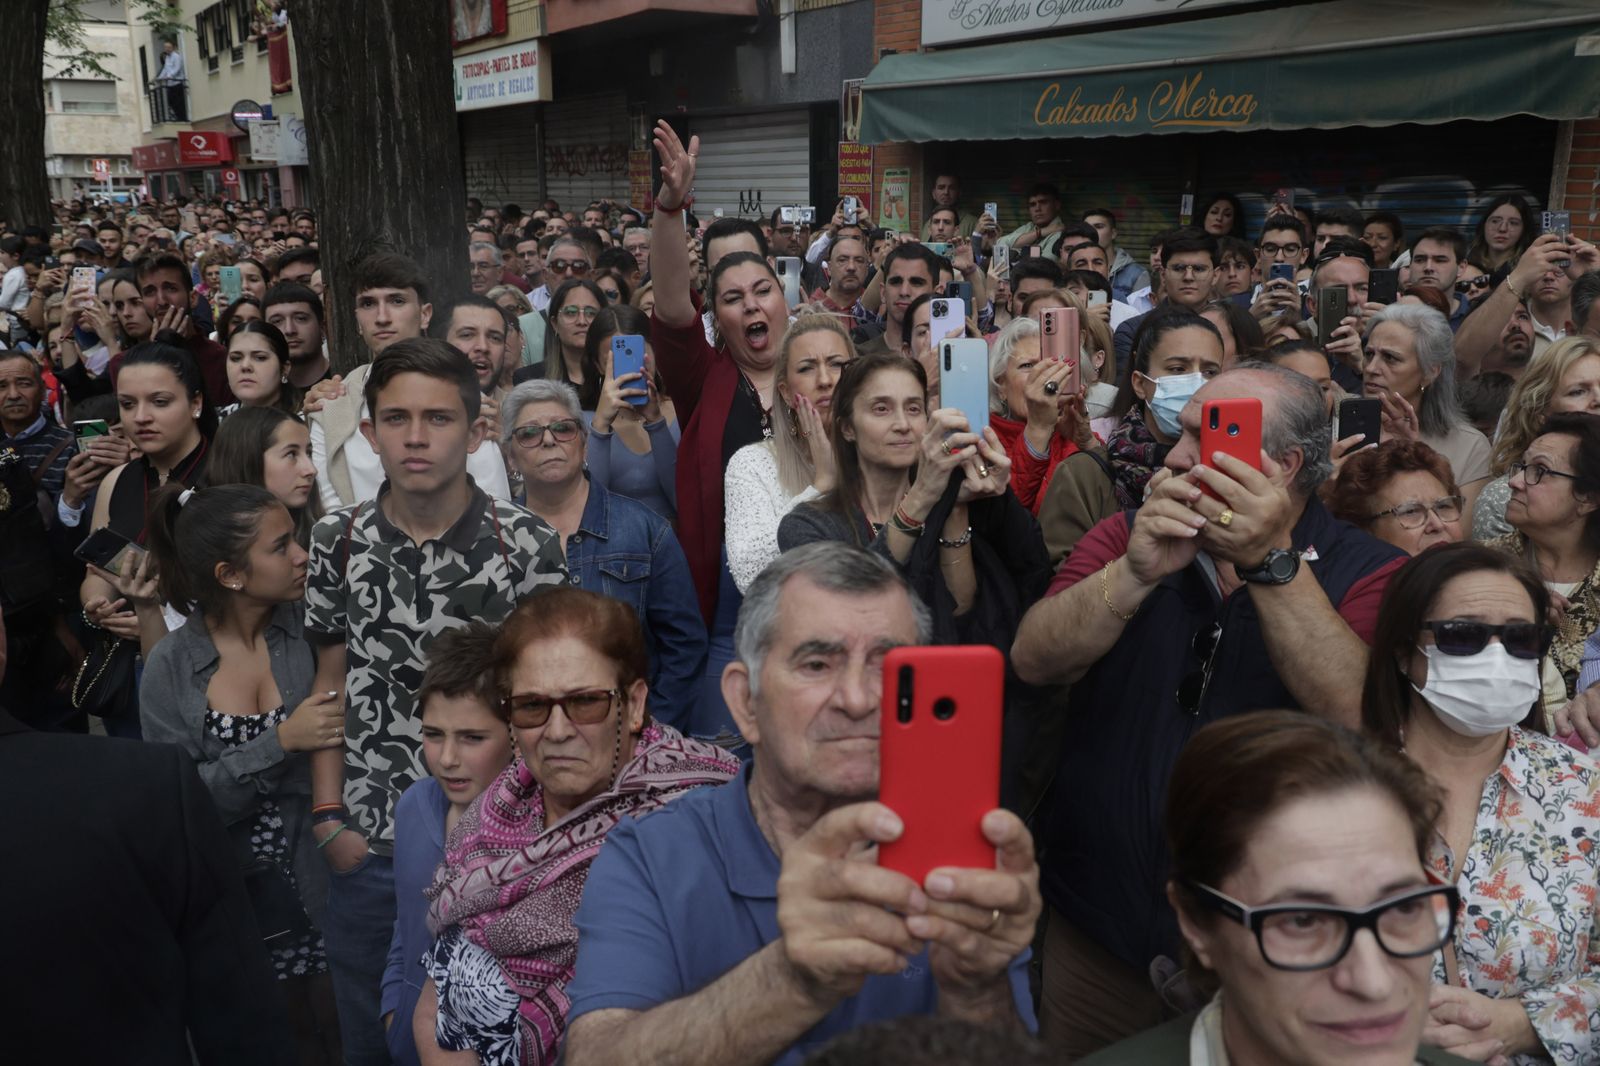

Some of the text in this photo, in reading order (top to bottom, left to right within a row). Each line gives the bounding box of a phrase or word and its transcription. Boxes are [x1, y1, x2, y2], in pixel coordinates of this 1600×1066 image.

[961, 3, 1031, 30] Anchos
[512, 55, 518, 70] DE
[520, 51, 536, 68] BODAS
[498, 81, 505, 96] DE
[1034, 70, 1257, 128] Calzados Merca
